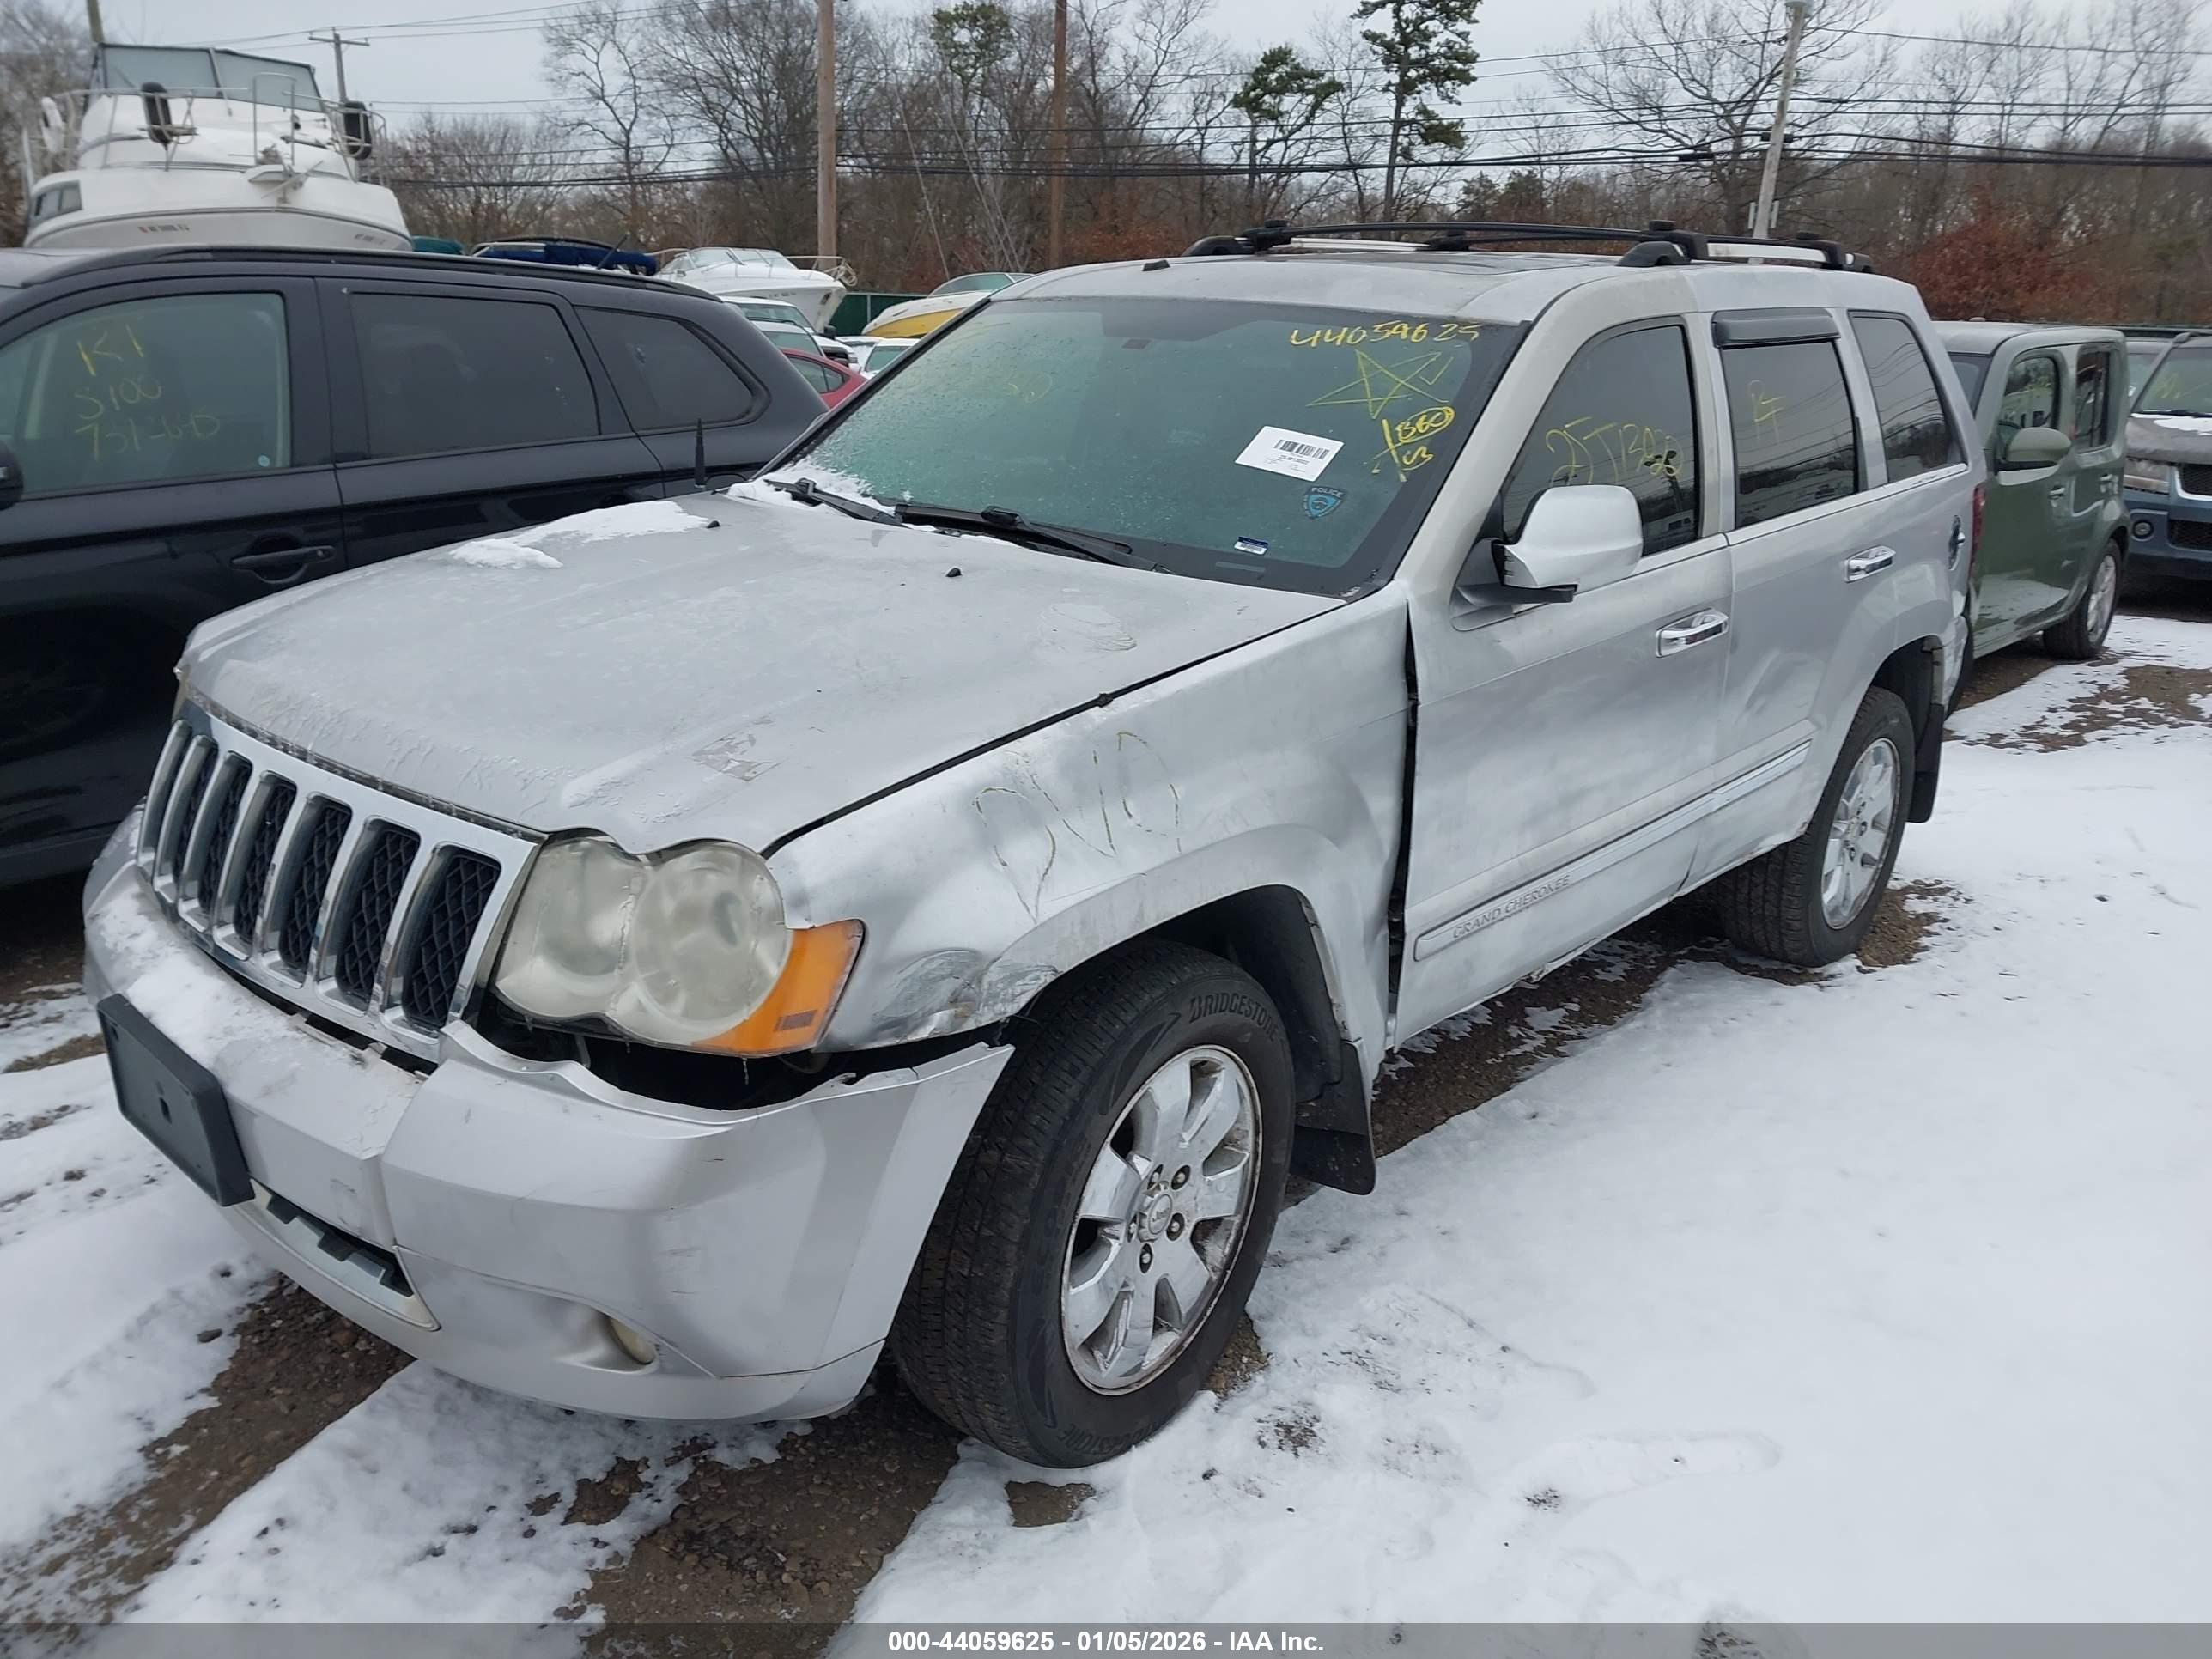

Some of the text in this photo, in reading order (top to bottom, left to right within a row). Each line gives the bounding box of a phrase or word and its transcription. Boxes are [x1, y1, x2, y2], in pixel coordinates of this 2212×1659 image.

[1311, 486, 1344, 498] POLICE
[1453, 875, 1571, 939] GRAND CHEROKEE
[1188, 992, 1279, 1041] BRIDGESTONE
